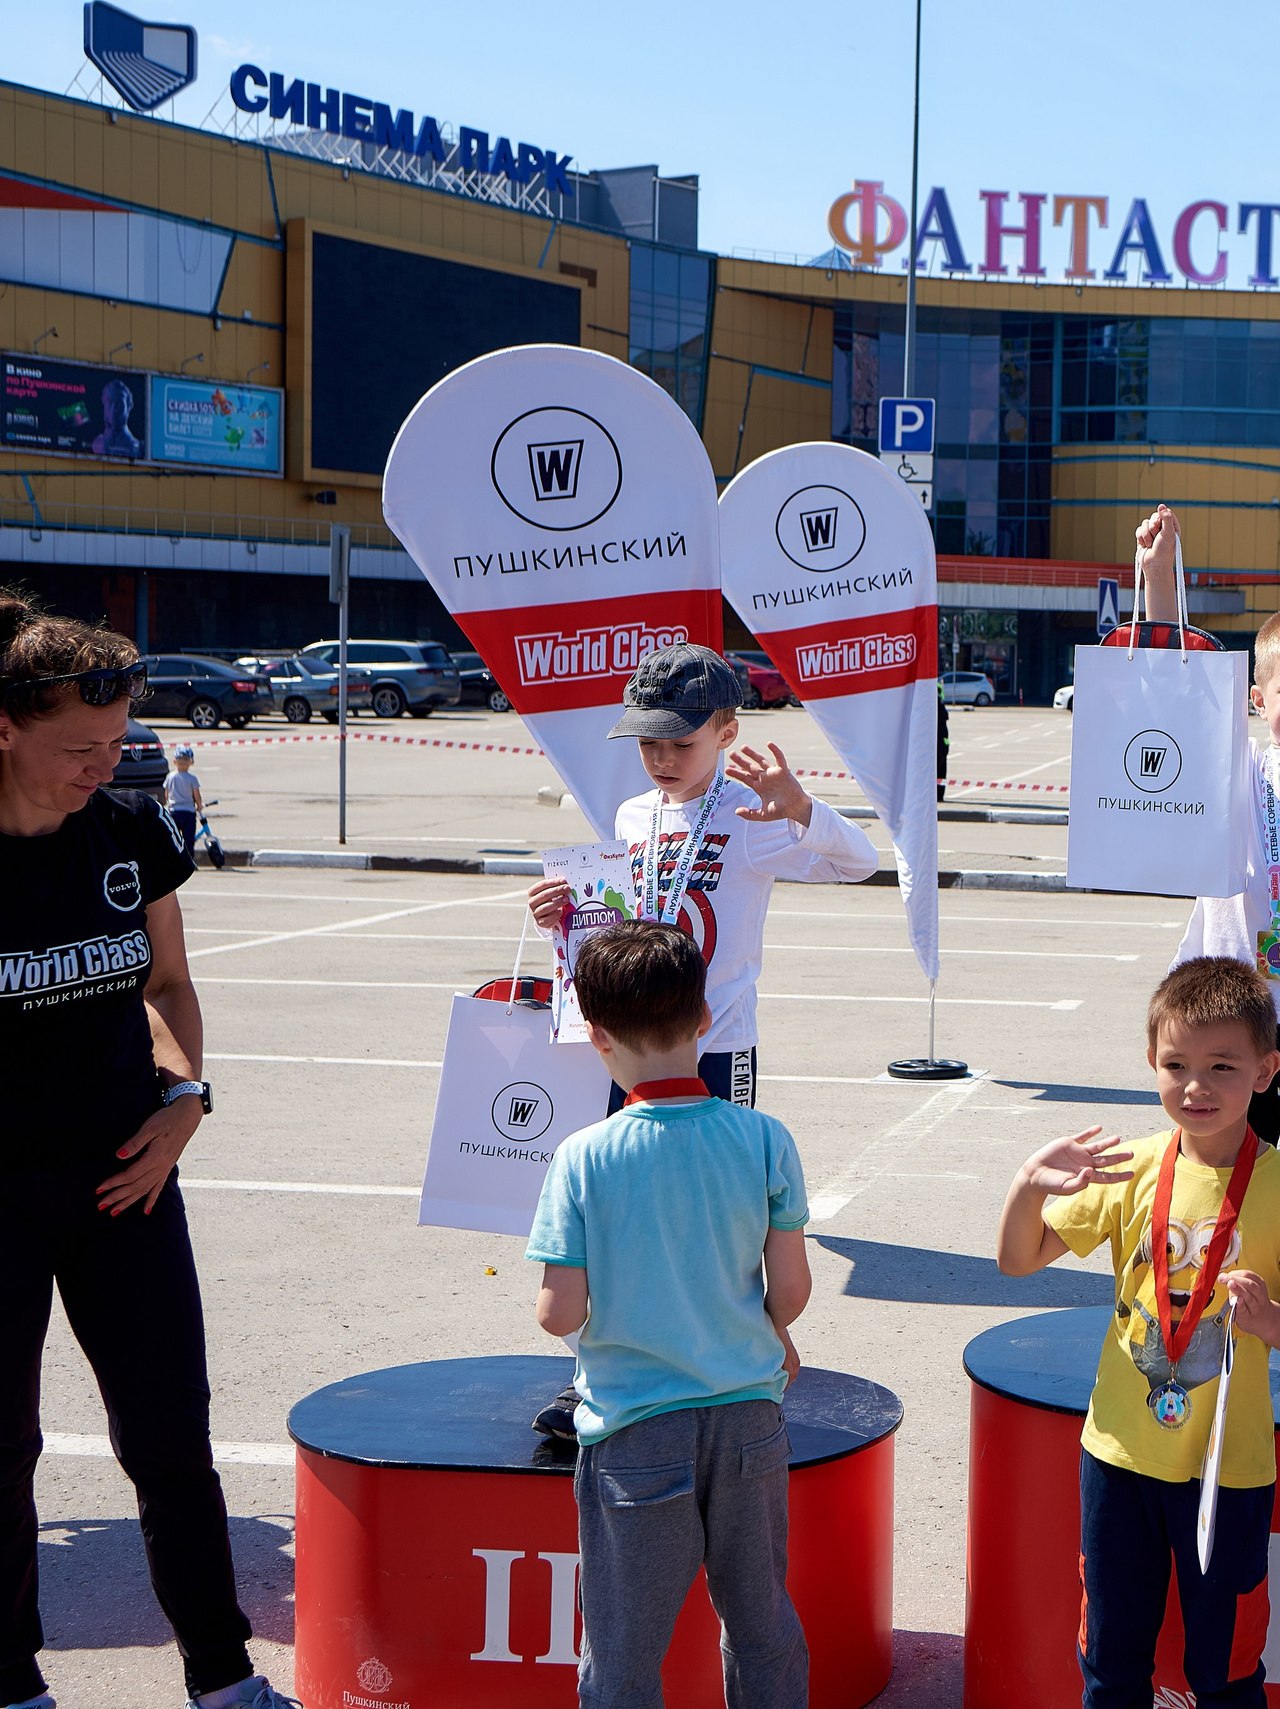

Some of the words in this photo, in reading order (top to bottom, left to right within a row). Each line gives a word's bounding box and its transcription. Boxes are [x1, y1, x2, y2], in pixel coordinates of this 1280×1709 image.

[230, 64, 446, 162] СИНЕМА
[460, 126, 574, 196] ПАРК
[6, 364, 14, 374] В
[16, 366, 42, 378] кино
[6, 376, 20, 386] по
[22, 376, 86, 394] Пушкинской
[6, 387, 38, 398] карте
[453, 531, 688, 578] ПУШКИНСКИЙ
[752, 568, 913, 610] ПУШКИНСКИЙ
[521, 634, 603, 680] World
[800, 643, 861, 680] World
[863, 636, 916, 668] Class
[1097, 796, 1206, 816] ПУШКИНСКИЙ
[647, 812, 658, 877] СОРЕВНОВАНИЯ
[685, 796, 716, 858] СОРЕВНОВАНИЯ
[1267, 826, 1279, 863] СЕТЕВЫЕ
[680, 858, 690, 872] ПО
[109, 881, 138, 894] VOLVO
[646, 878, 654, 915] СЕТЕВЫЕ
[668, 873, 684, 916] РОЛИКАМ
[572, 910, 616, 930] ДИПЛОМ
[0, 949, 78, 992] World
[84, 934, 149, 975] Class
[23, 976, 138, 1010] ПУШКИНСКИЙ
[342, 1690, 411, 1709] Пушкинский
